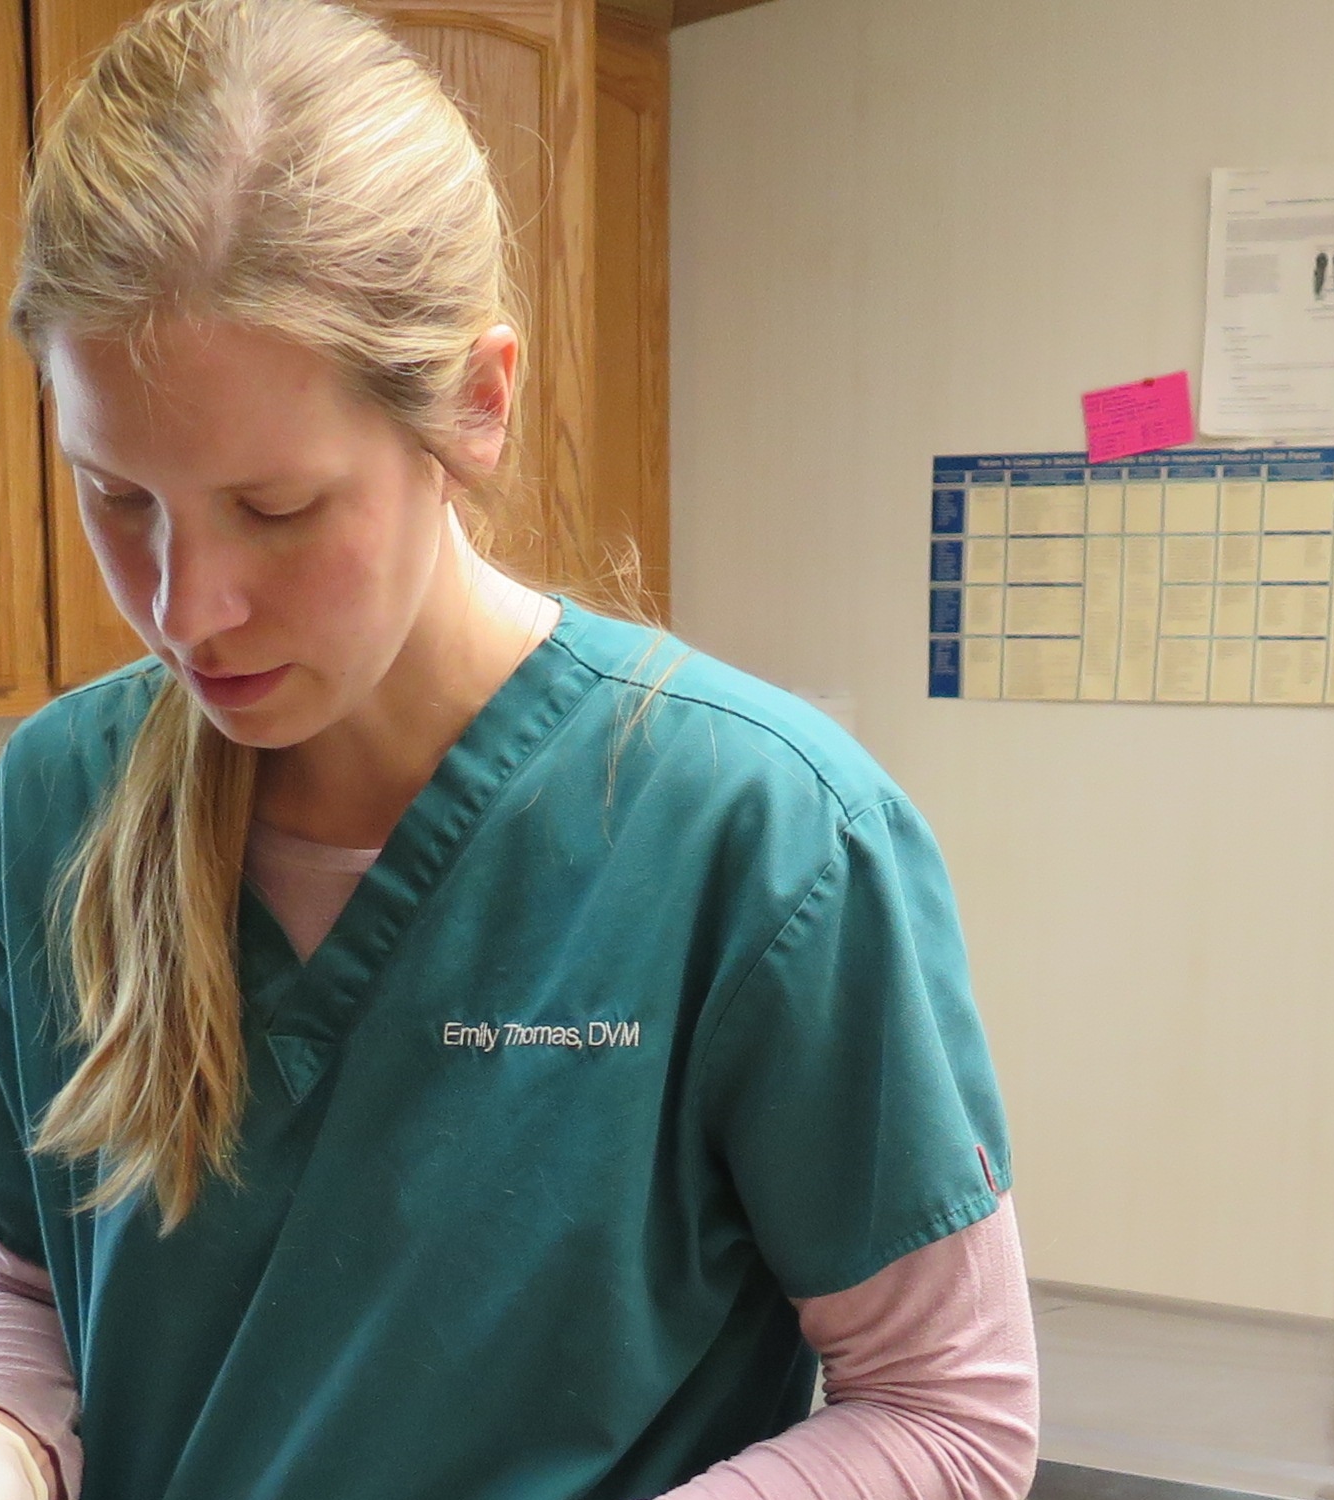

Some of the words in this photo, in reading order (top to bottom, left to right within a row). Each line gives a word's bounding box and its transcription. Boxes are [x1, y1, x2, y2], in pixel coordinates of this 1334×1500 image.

[443, 1022, 500, 1053] Emily
[503, 1023, 583, 1050] Thomas,
[588, 1021, 640, 1048] DVM
